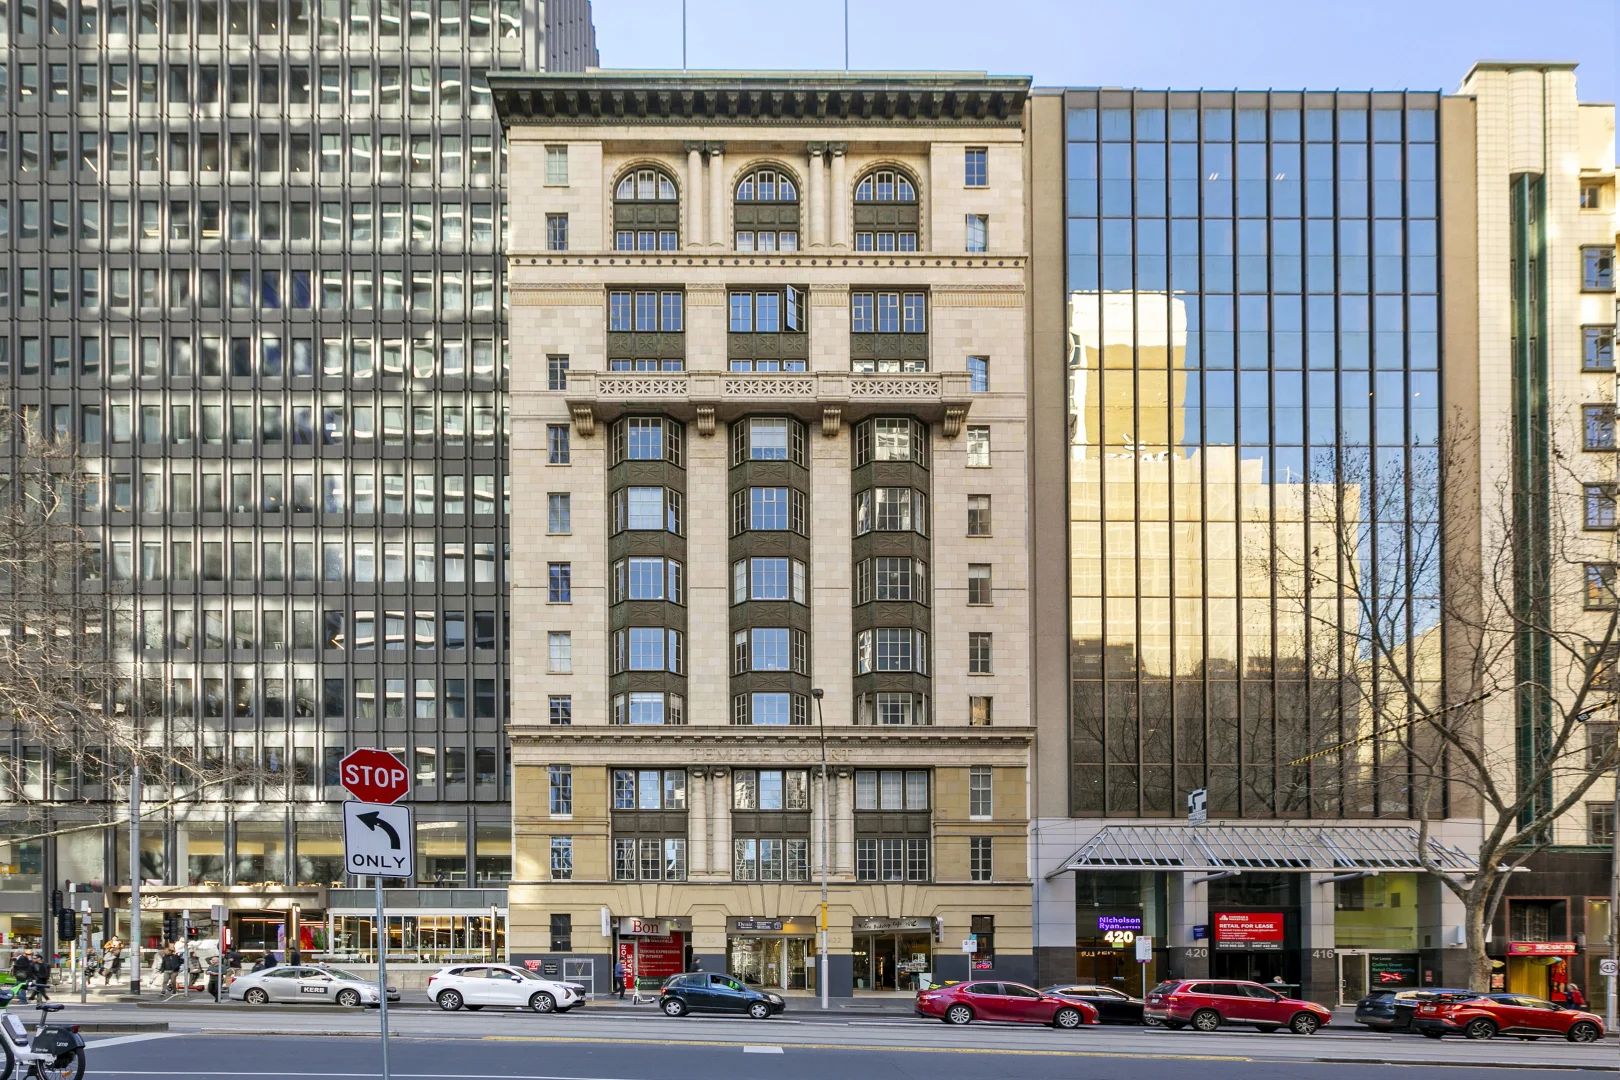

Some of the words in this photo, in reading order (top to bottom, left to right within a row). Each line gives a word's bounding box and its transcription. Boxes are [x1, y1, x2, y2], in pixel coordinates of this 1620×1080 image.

[690, 748, 772, 761] TEMPLE
[784, 748, 853, 761] COURT
[345, 764, 405, 789] STOP
[352, 853, 406, 869] ONLY
[632, 919, 660, 934] Bon
[1099, 922, 1120, 931] Ryan
[1104, 930, 1134, 943] 420
[1185, 948, 1208, 958] 420
[1312, 949, 1334, 959] 416
[1602, 962, 1616, 971] 40
